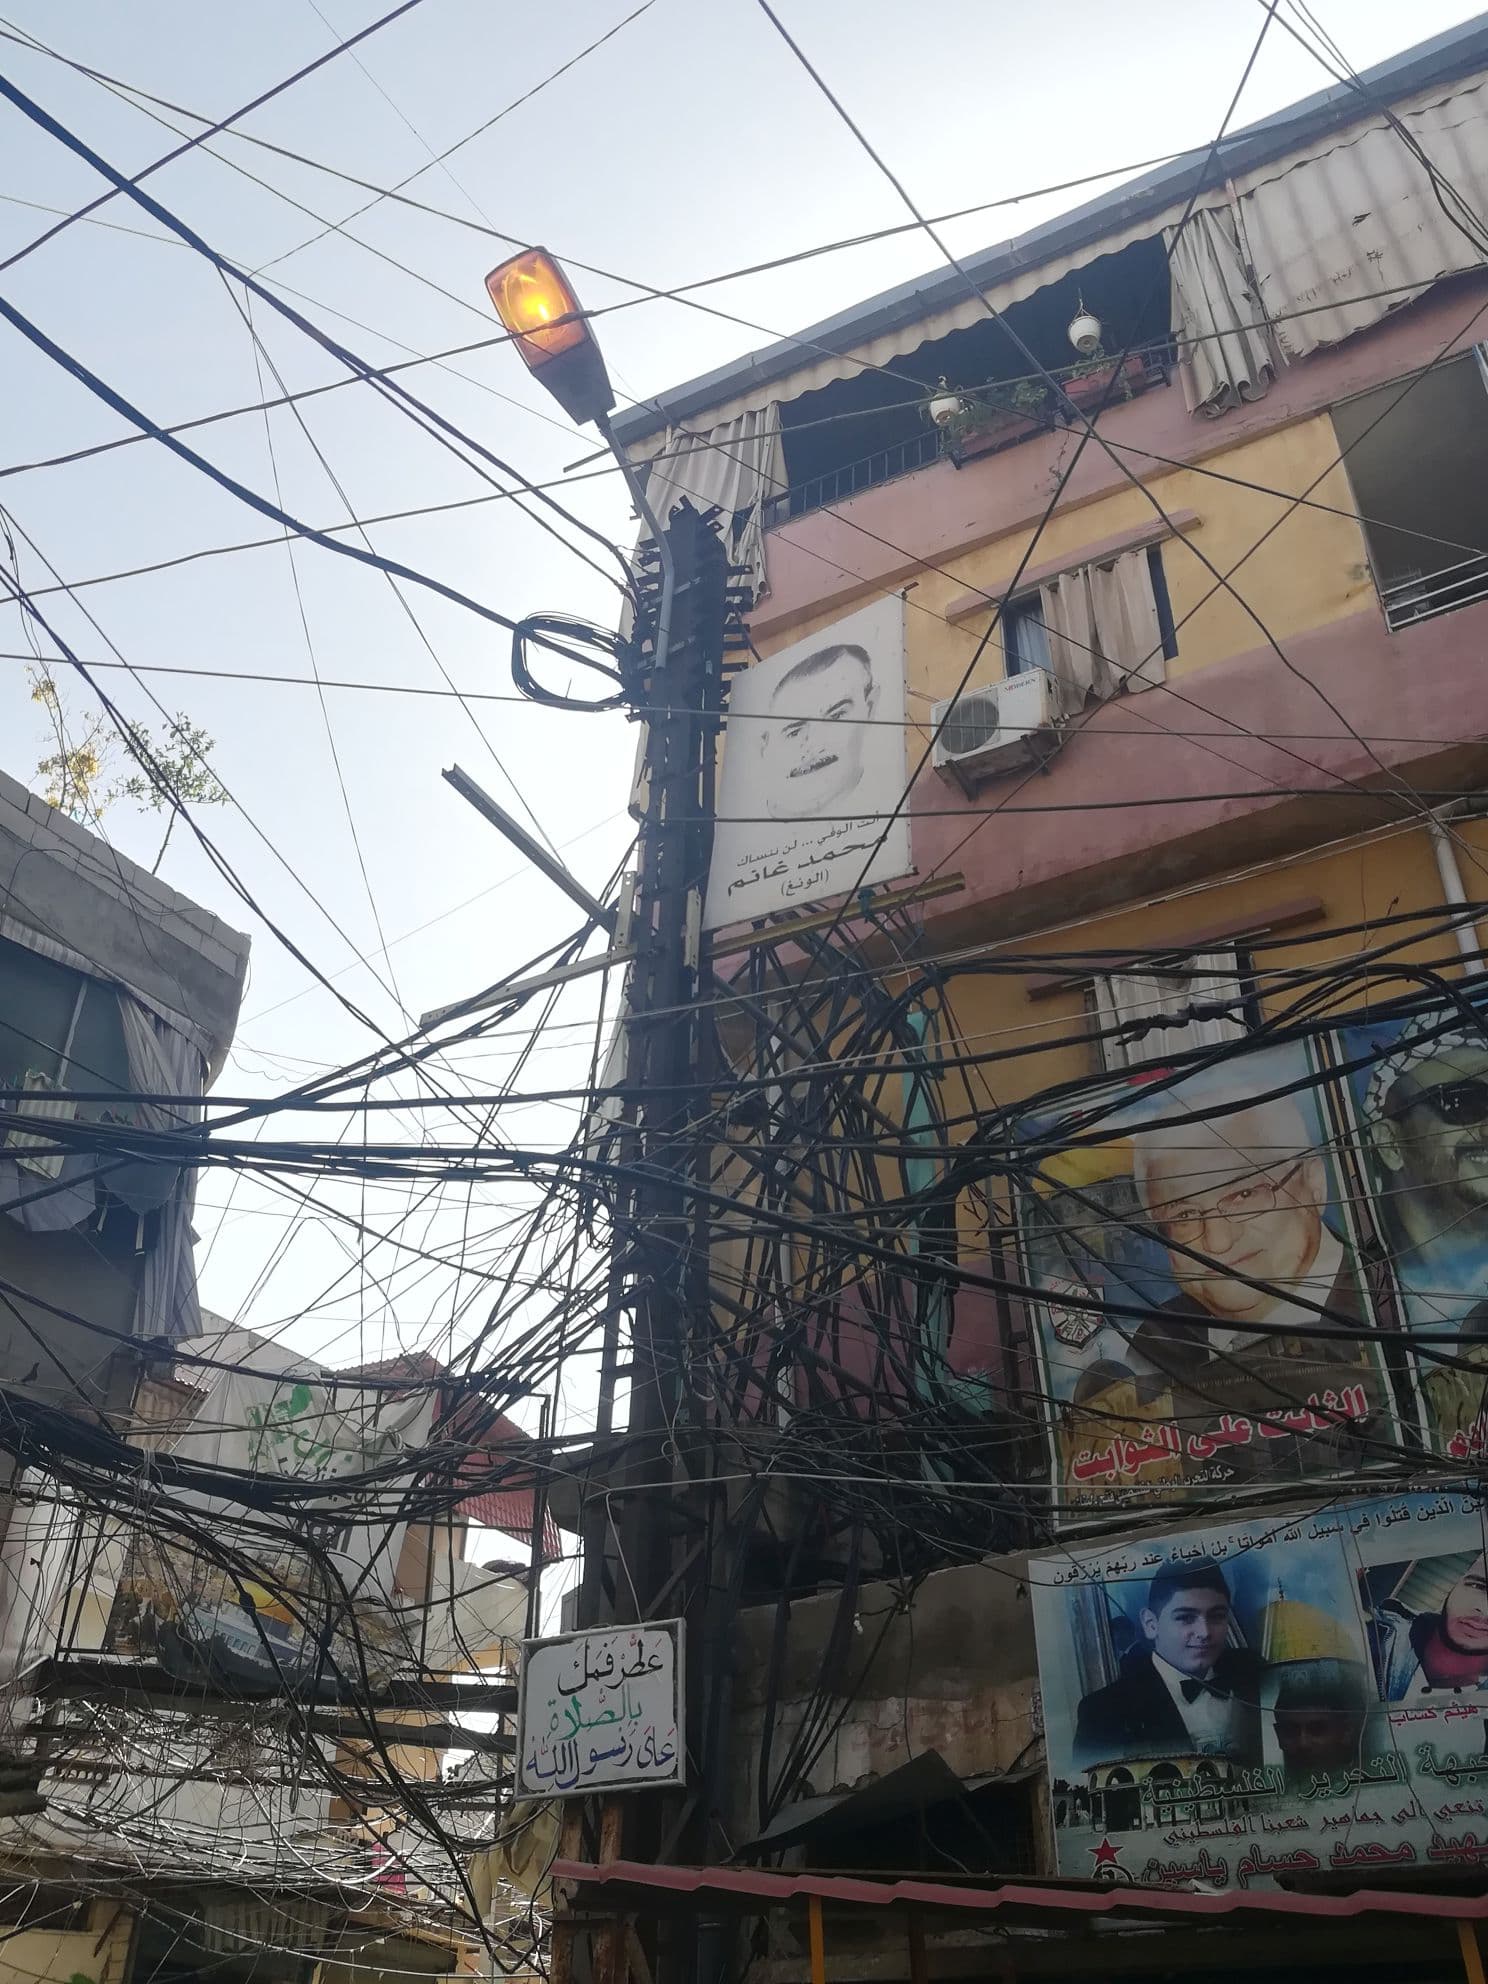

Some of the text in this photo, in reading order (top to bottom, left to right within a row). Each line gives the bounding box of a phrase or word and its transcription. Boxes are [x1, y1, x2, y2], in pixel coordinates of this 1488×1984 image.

[782, 840, 797, 855] لن
[817, 822, 853, 844] الوفي
[727, 834, 889, 896] محمد غانم
[1071, 1420, 1184, 1482] الثوابت
[1187, 1412, 1254, 1462] على
[1211, 1464, 1236, 1481] حركة
[1308, 1523, 1344, 1541] سبيل
[1142, 1553, 1163, 1566] عند
[1443, 1701, 1479, 1725] هيثم
[1141, 1767, 1286, 1813] الفلسطينية
[1298, 1753, 1408, 1800] التحرير
[1163, 1813, 1257, 1849] الفلسطيني
[1260, 1811, 1309, 1835] شعبنا
[1320, 1805, 1384, 1834] جماهير
[1141, 1848, 1229, 1887] ياسين
[1237, 1843, 1320, 1889] حسام
[1330, 1840, 1417, 1867] محمد
